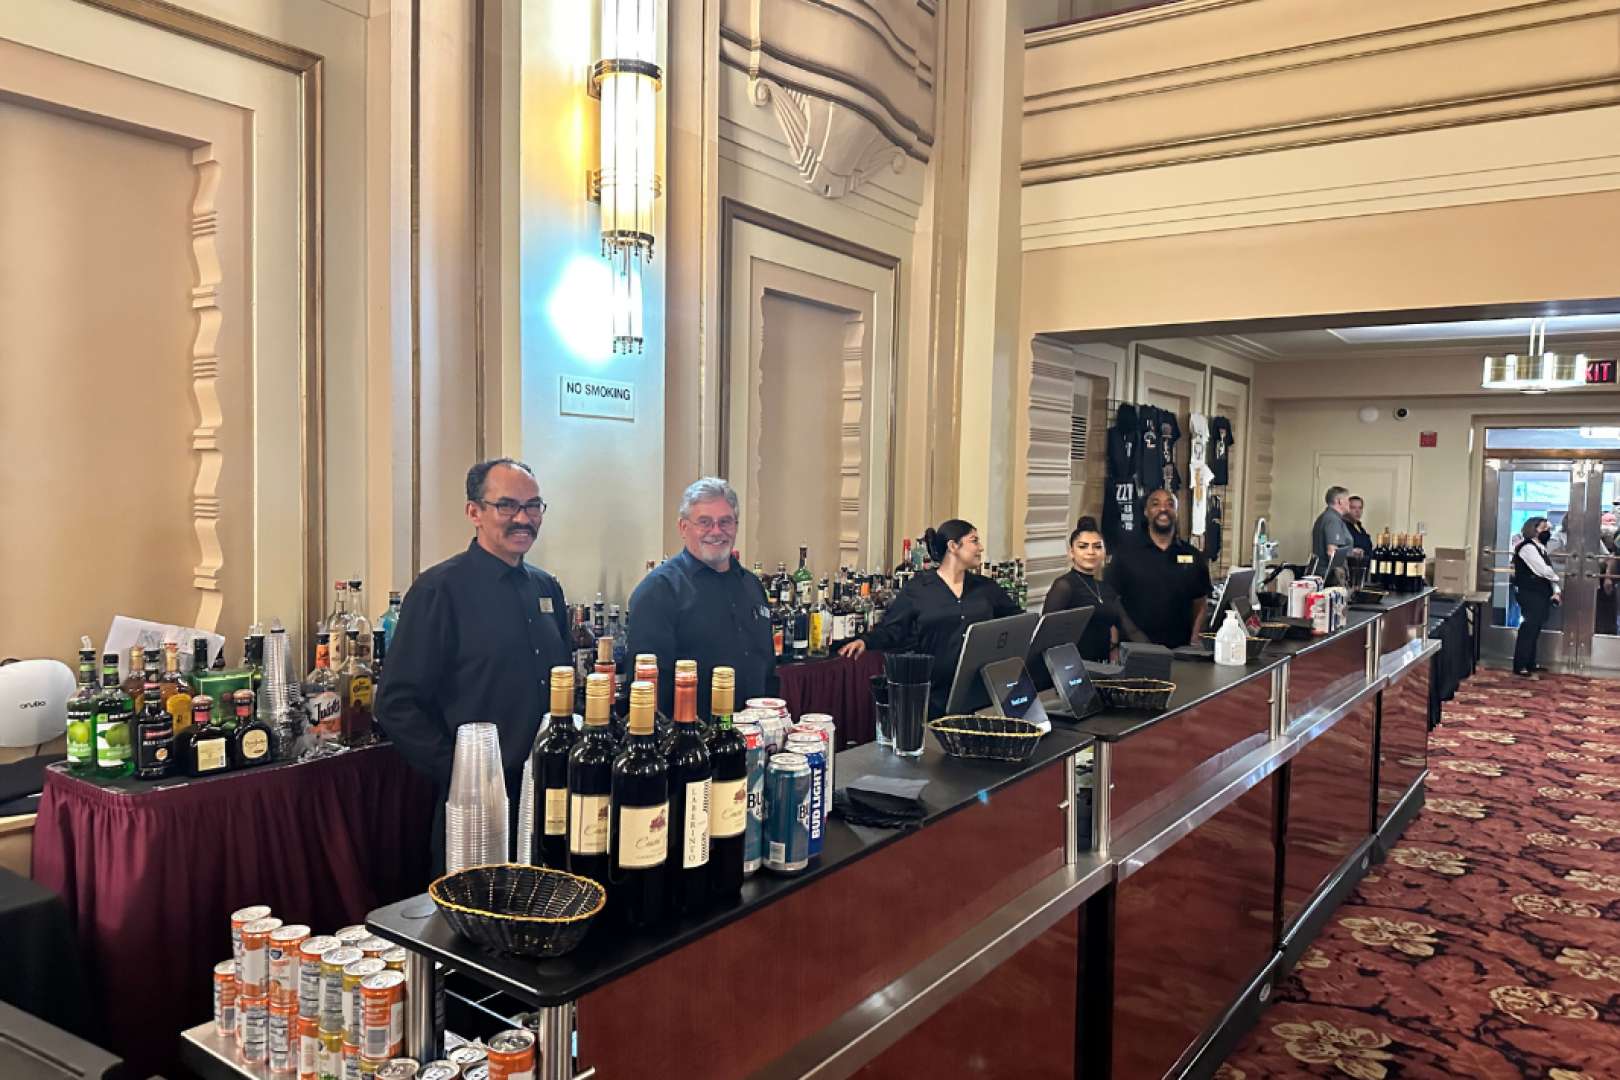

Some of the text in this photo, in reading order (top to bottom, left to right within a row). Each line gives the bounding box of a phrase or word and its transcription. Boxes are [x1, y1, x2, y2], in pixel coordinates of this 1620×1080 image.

[566, 382, 630, 400] NO SMOKING
[811, 767, 823, 839] BUD LIGHT
